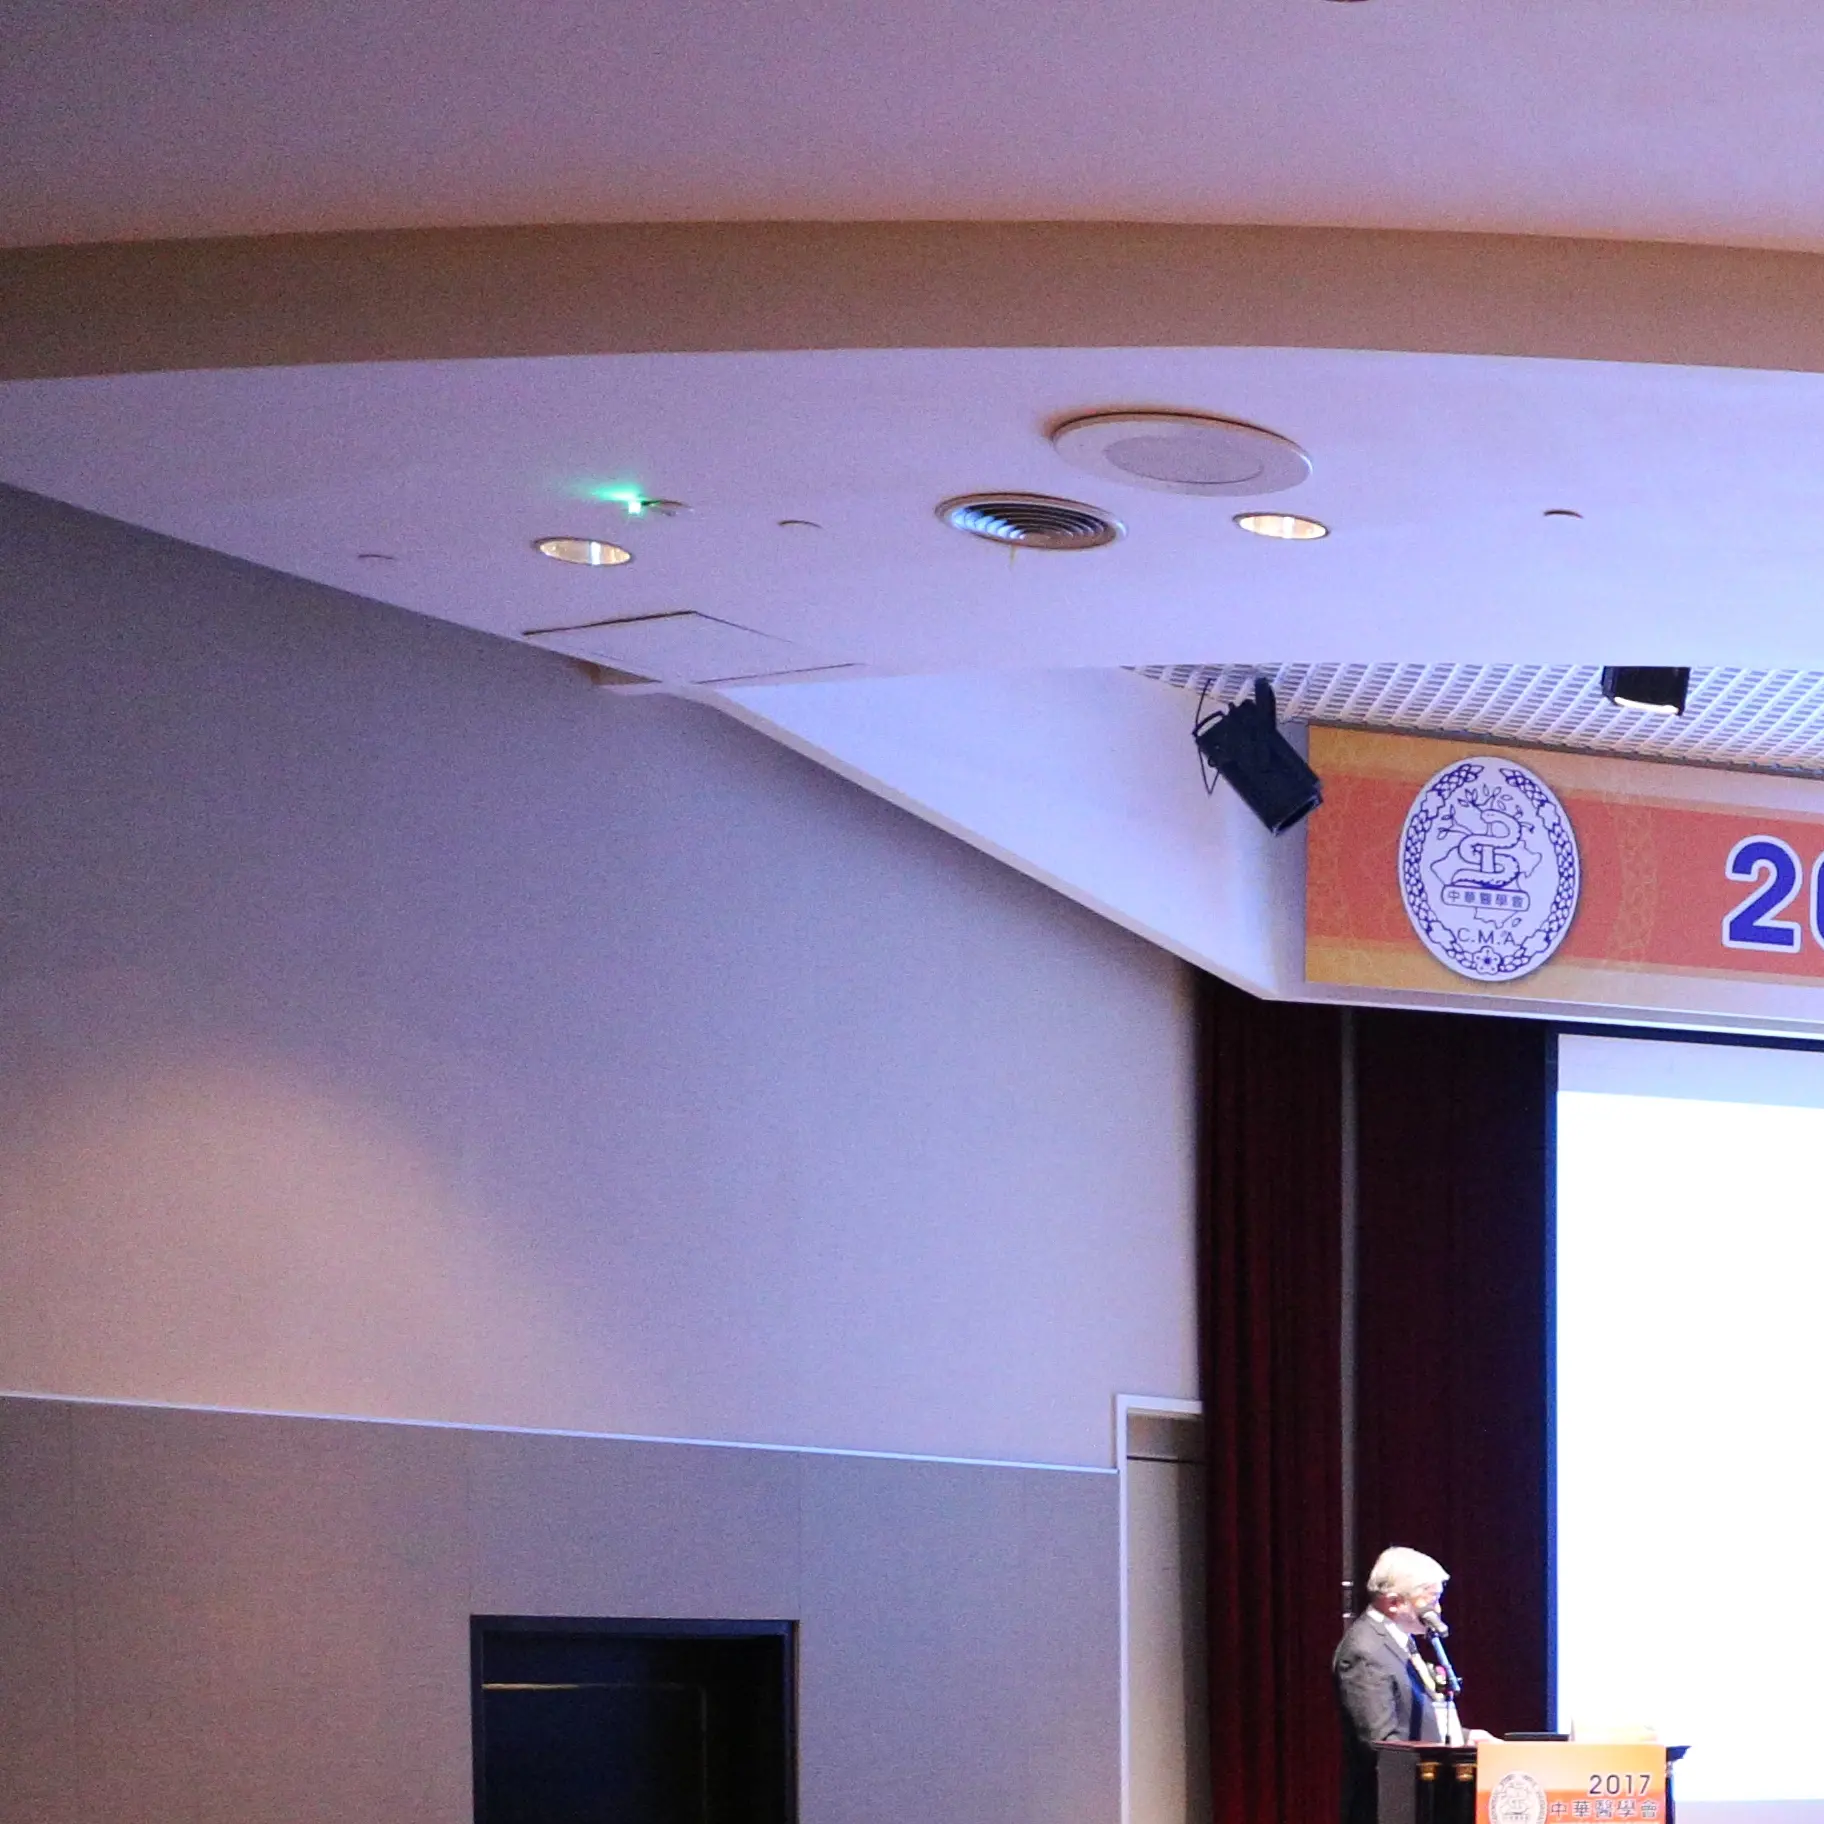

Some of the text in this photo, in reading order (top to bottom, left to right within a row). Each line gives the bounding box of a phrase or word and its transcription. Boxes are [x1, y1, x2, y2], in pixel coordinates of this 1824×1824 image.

[1448, 890, 1524, 908] 中華醫學會
[1589, 1774, 1650, 1795] 2017
[1551, 1800, 1657, 1818] 中華醫學會
